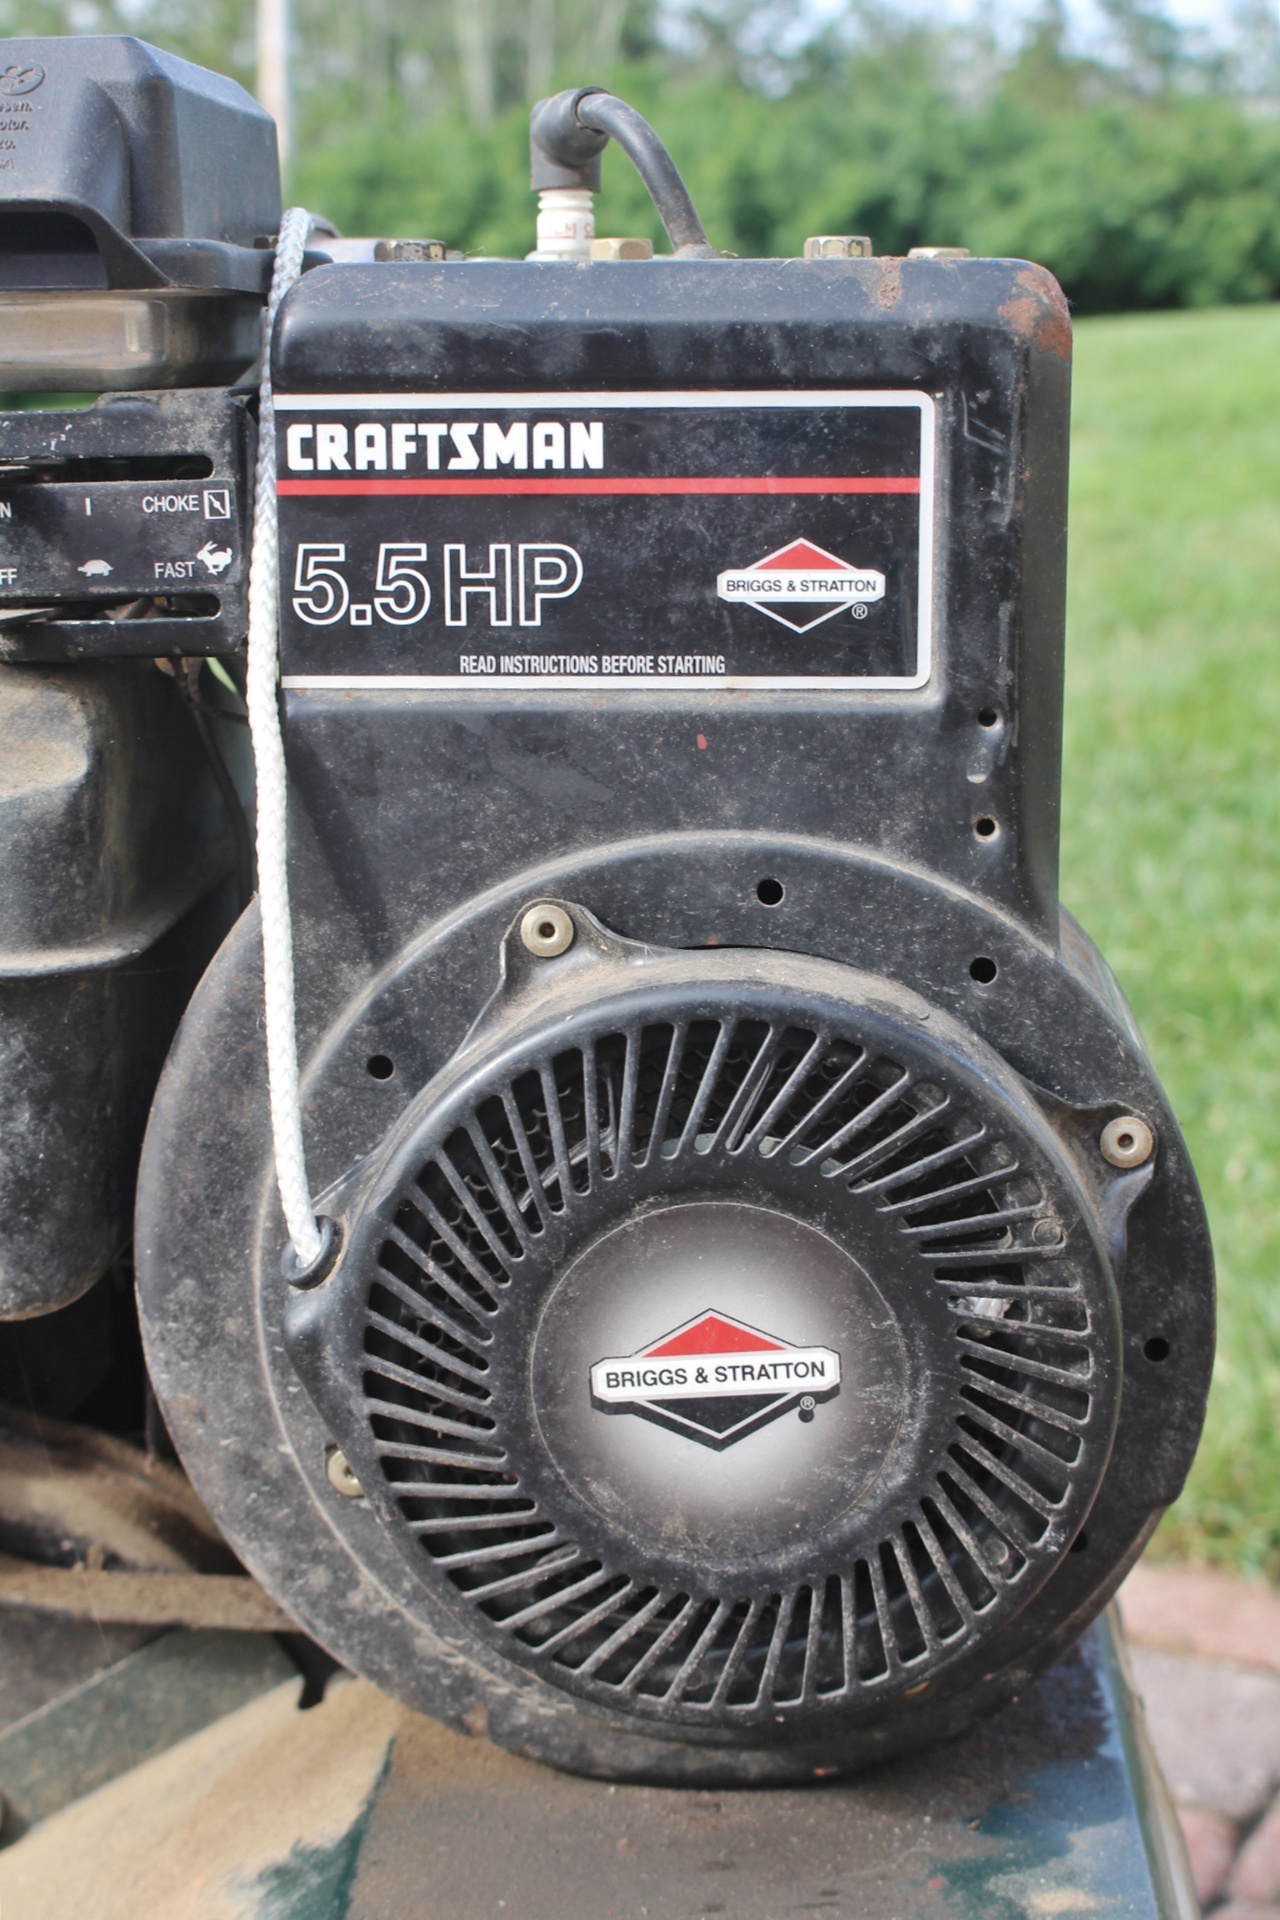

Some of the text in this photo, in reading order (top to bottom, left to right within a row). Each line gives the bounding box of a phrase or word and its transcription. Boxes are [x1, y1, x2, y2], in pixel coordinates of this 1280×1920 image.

[286, 421, 604, 471] CRAFTSMAN
[142, 495, 200, 514] CHOKE
[154, 561, 195, 579] FAST
[726, 579, 877, 593] BRIGGS & STRATTON
[459, 655, 726, 674] READ INSTRUCTIONS BEFORE STARTING
[606, 1361, 826, 1389] BRIGGS & STRATTON
